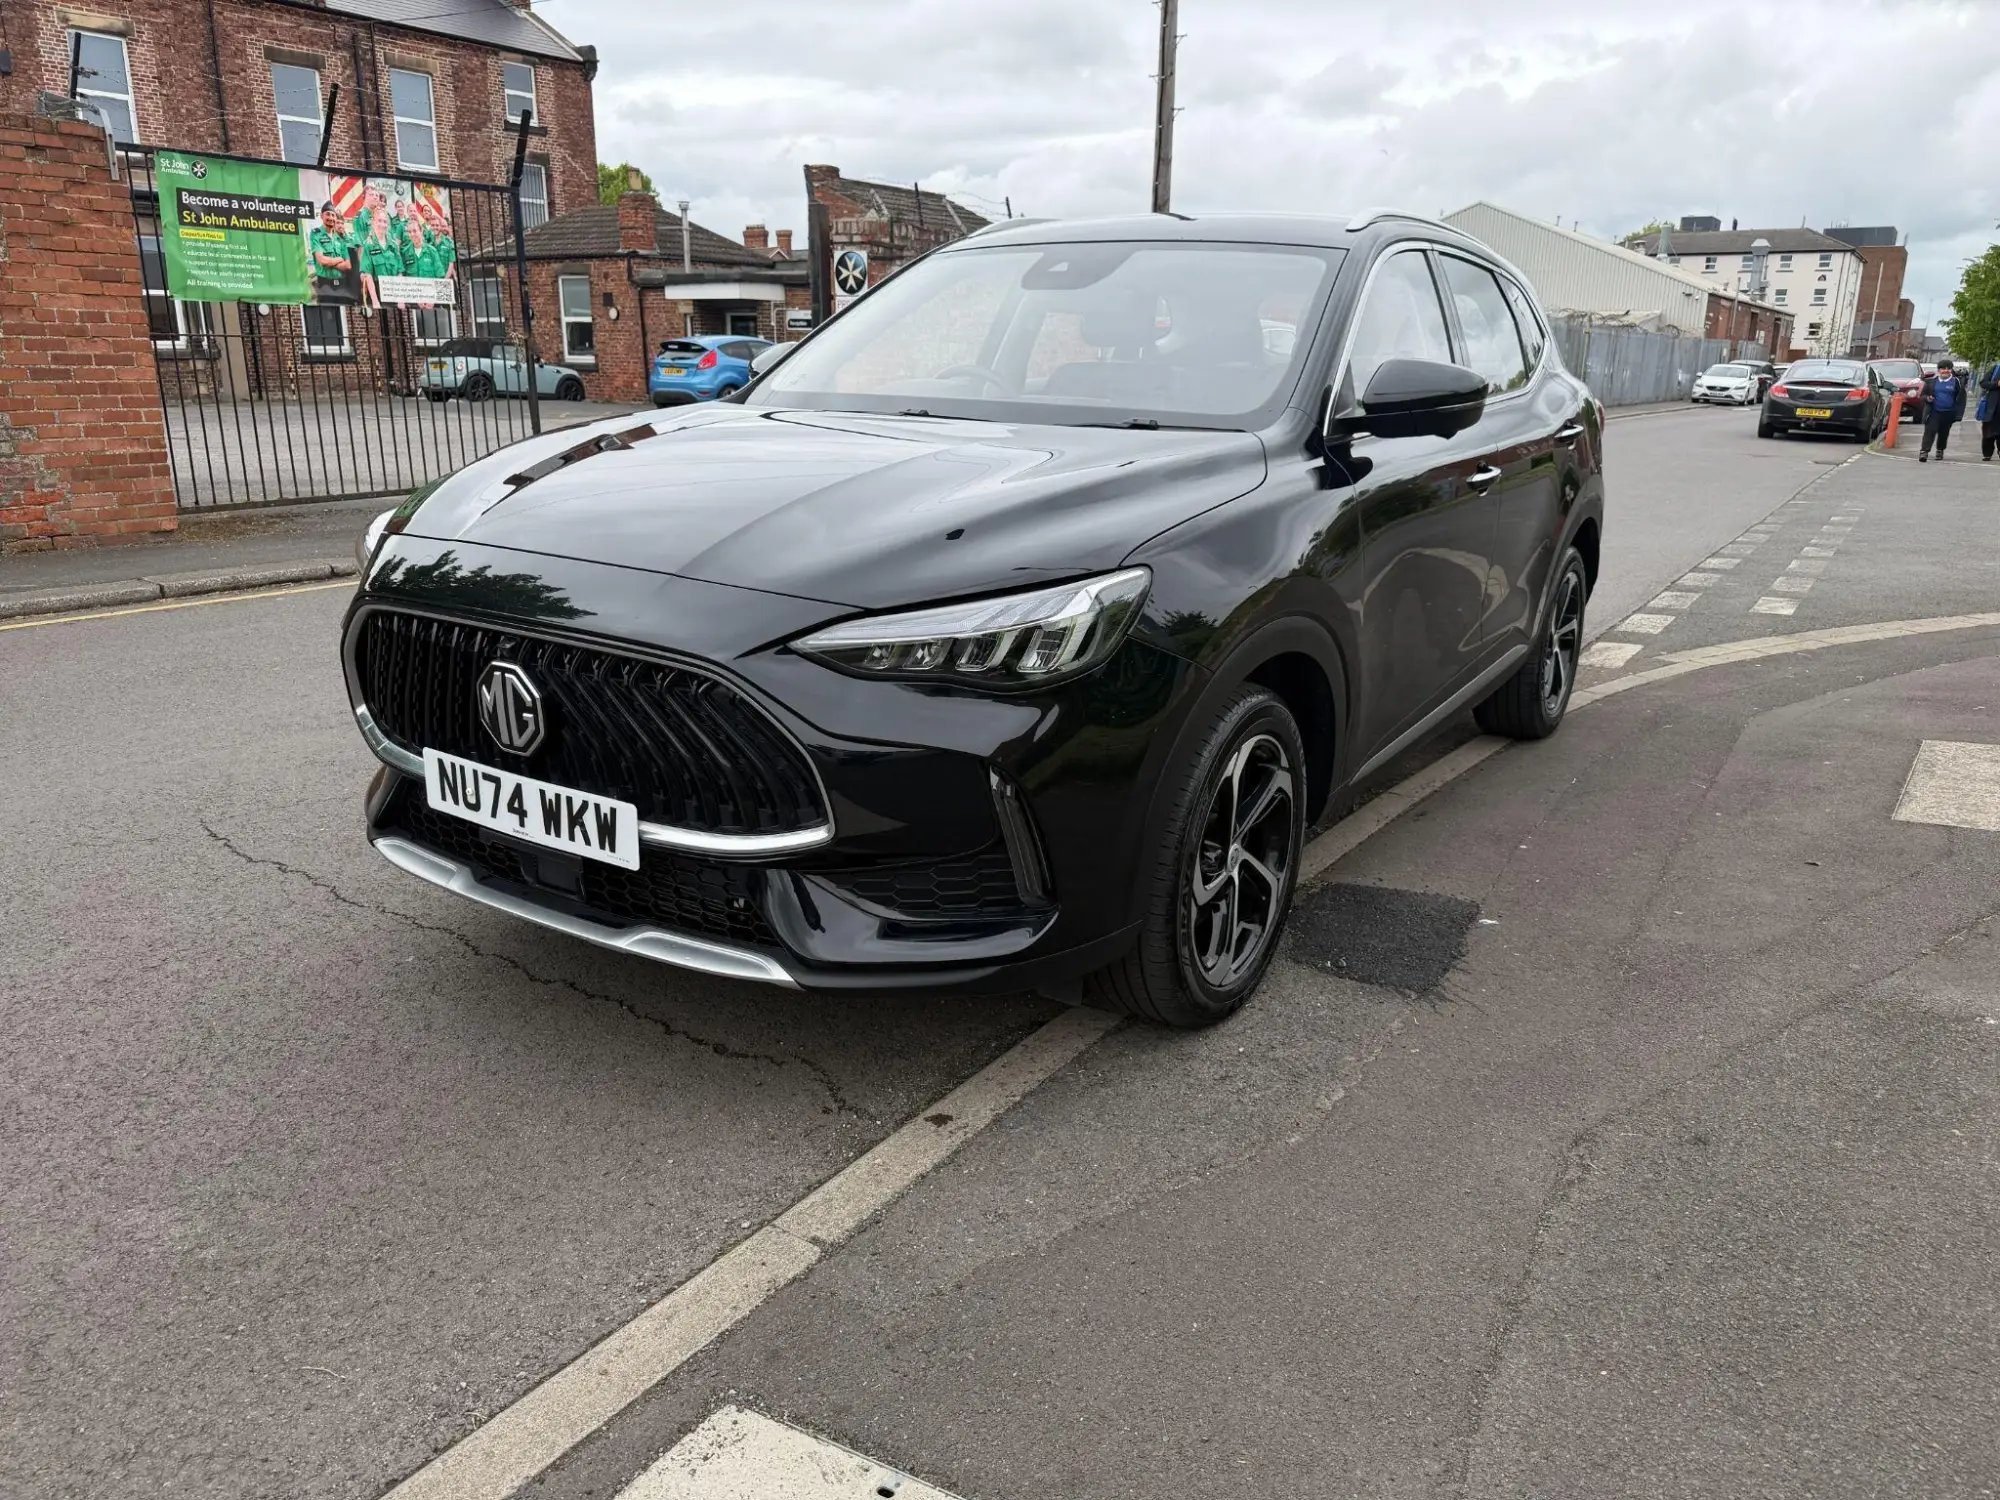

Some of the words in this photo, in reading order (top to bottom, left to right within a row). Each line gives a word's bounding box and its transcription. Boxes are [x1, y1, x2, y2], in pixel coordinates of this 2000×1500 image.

[160, 158, 171, 168] St
[171, 159, 190, 170] John
[181, 191, 229, 208] Become
[231, 200, 239, 209] a
[241, 201, 297, 215] volunteer
[298, 204, 310, 216] at
[183, 210, 197, 224] St
[200, 212, 228, 227] John
[230, 215, 296, 232] Ambulance
[197, 279, 220, 289] training
[481, 671, 536, 748] MG
[437, 757, 529, 829] NU74
[539, 788, 617, 854] WKW
